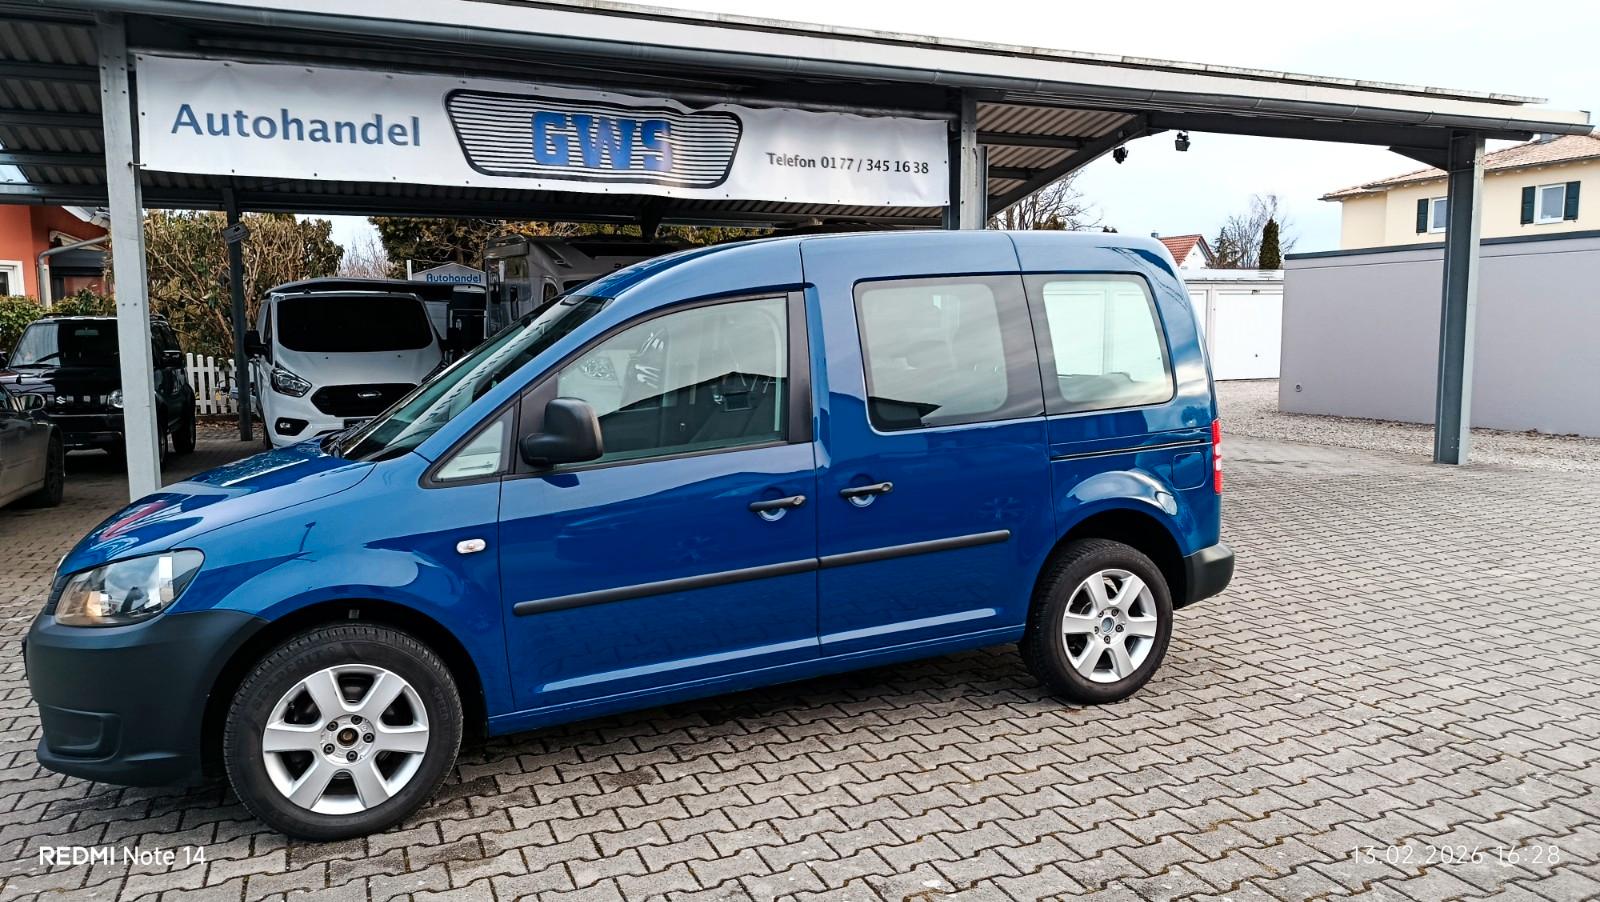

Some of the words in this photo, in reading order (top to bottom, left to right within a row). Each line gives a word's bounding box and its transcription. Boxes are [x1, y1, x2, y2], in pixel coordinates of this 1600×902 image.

[171, 103, 421, 147] Autohandel
[531, 110, 673, 172] GWS
[765, 152, 816, 168] Telefon
[866, 158, 890, 172] 345
[426, 273, 482, 284] Autohandel
